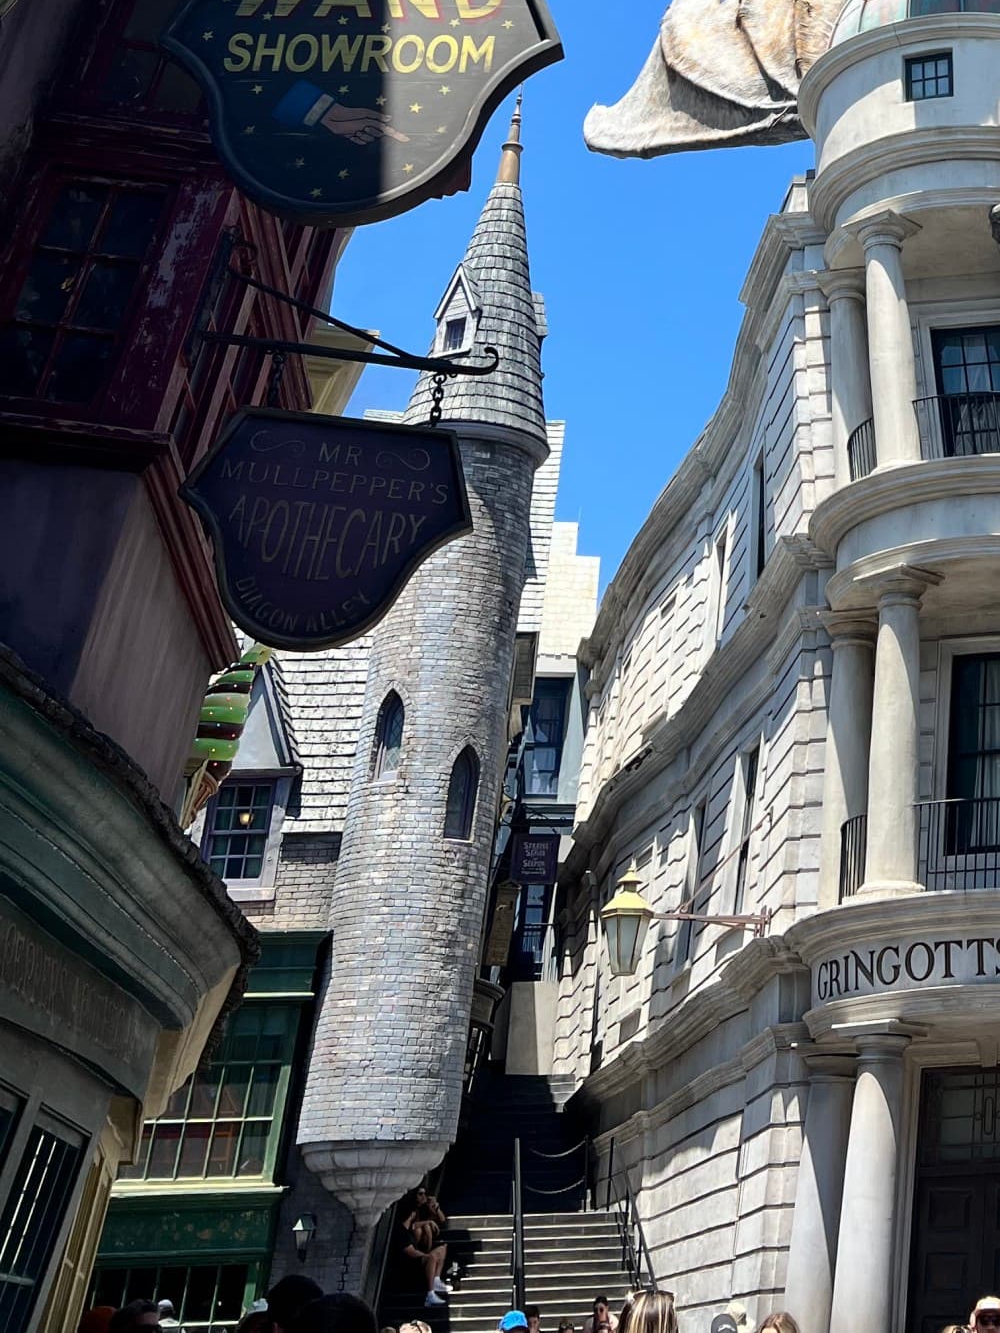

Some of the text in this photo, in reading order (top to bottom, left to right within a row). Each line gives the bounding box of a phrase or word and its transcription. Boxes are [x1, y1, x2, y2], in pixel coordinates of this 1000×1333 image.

[223, 32, 497, 74] SHOWROOM
[318, 441, 363, 467] MR
[220, 457, 450, 506] MULLPEPPER'S
[228, 493, 429, 581] APOTHECARY
